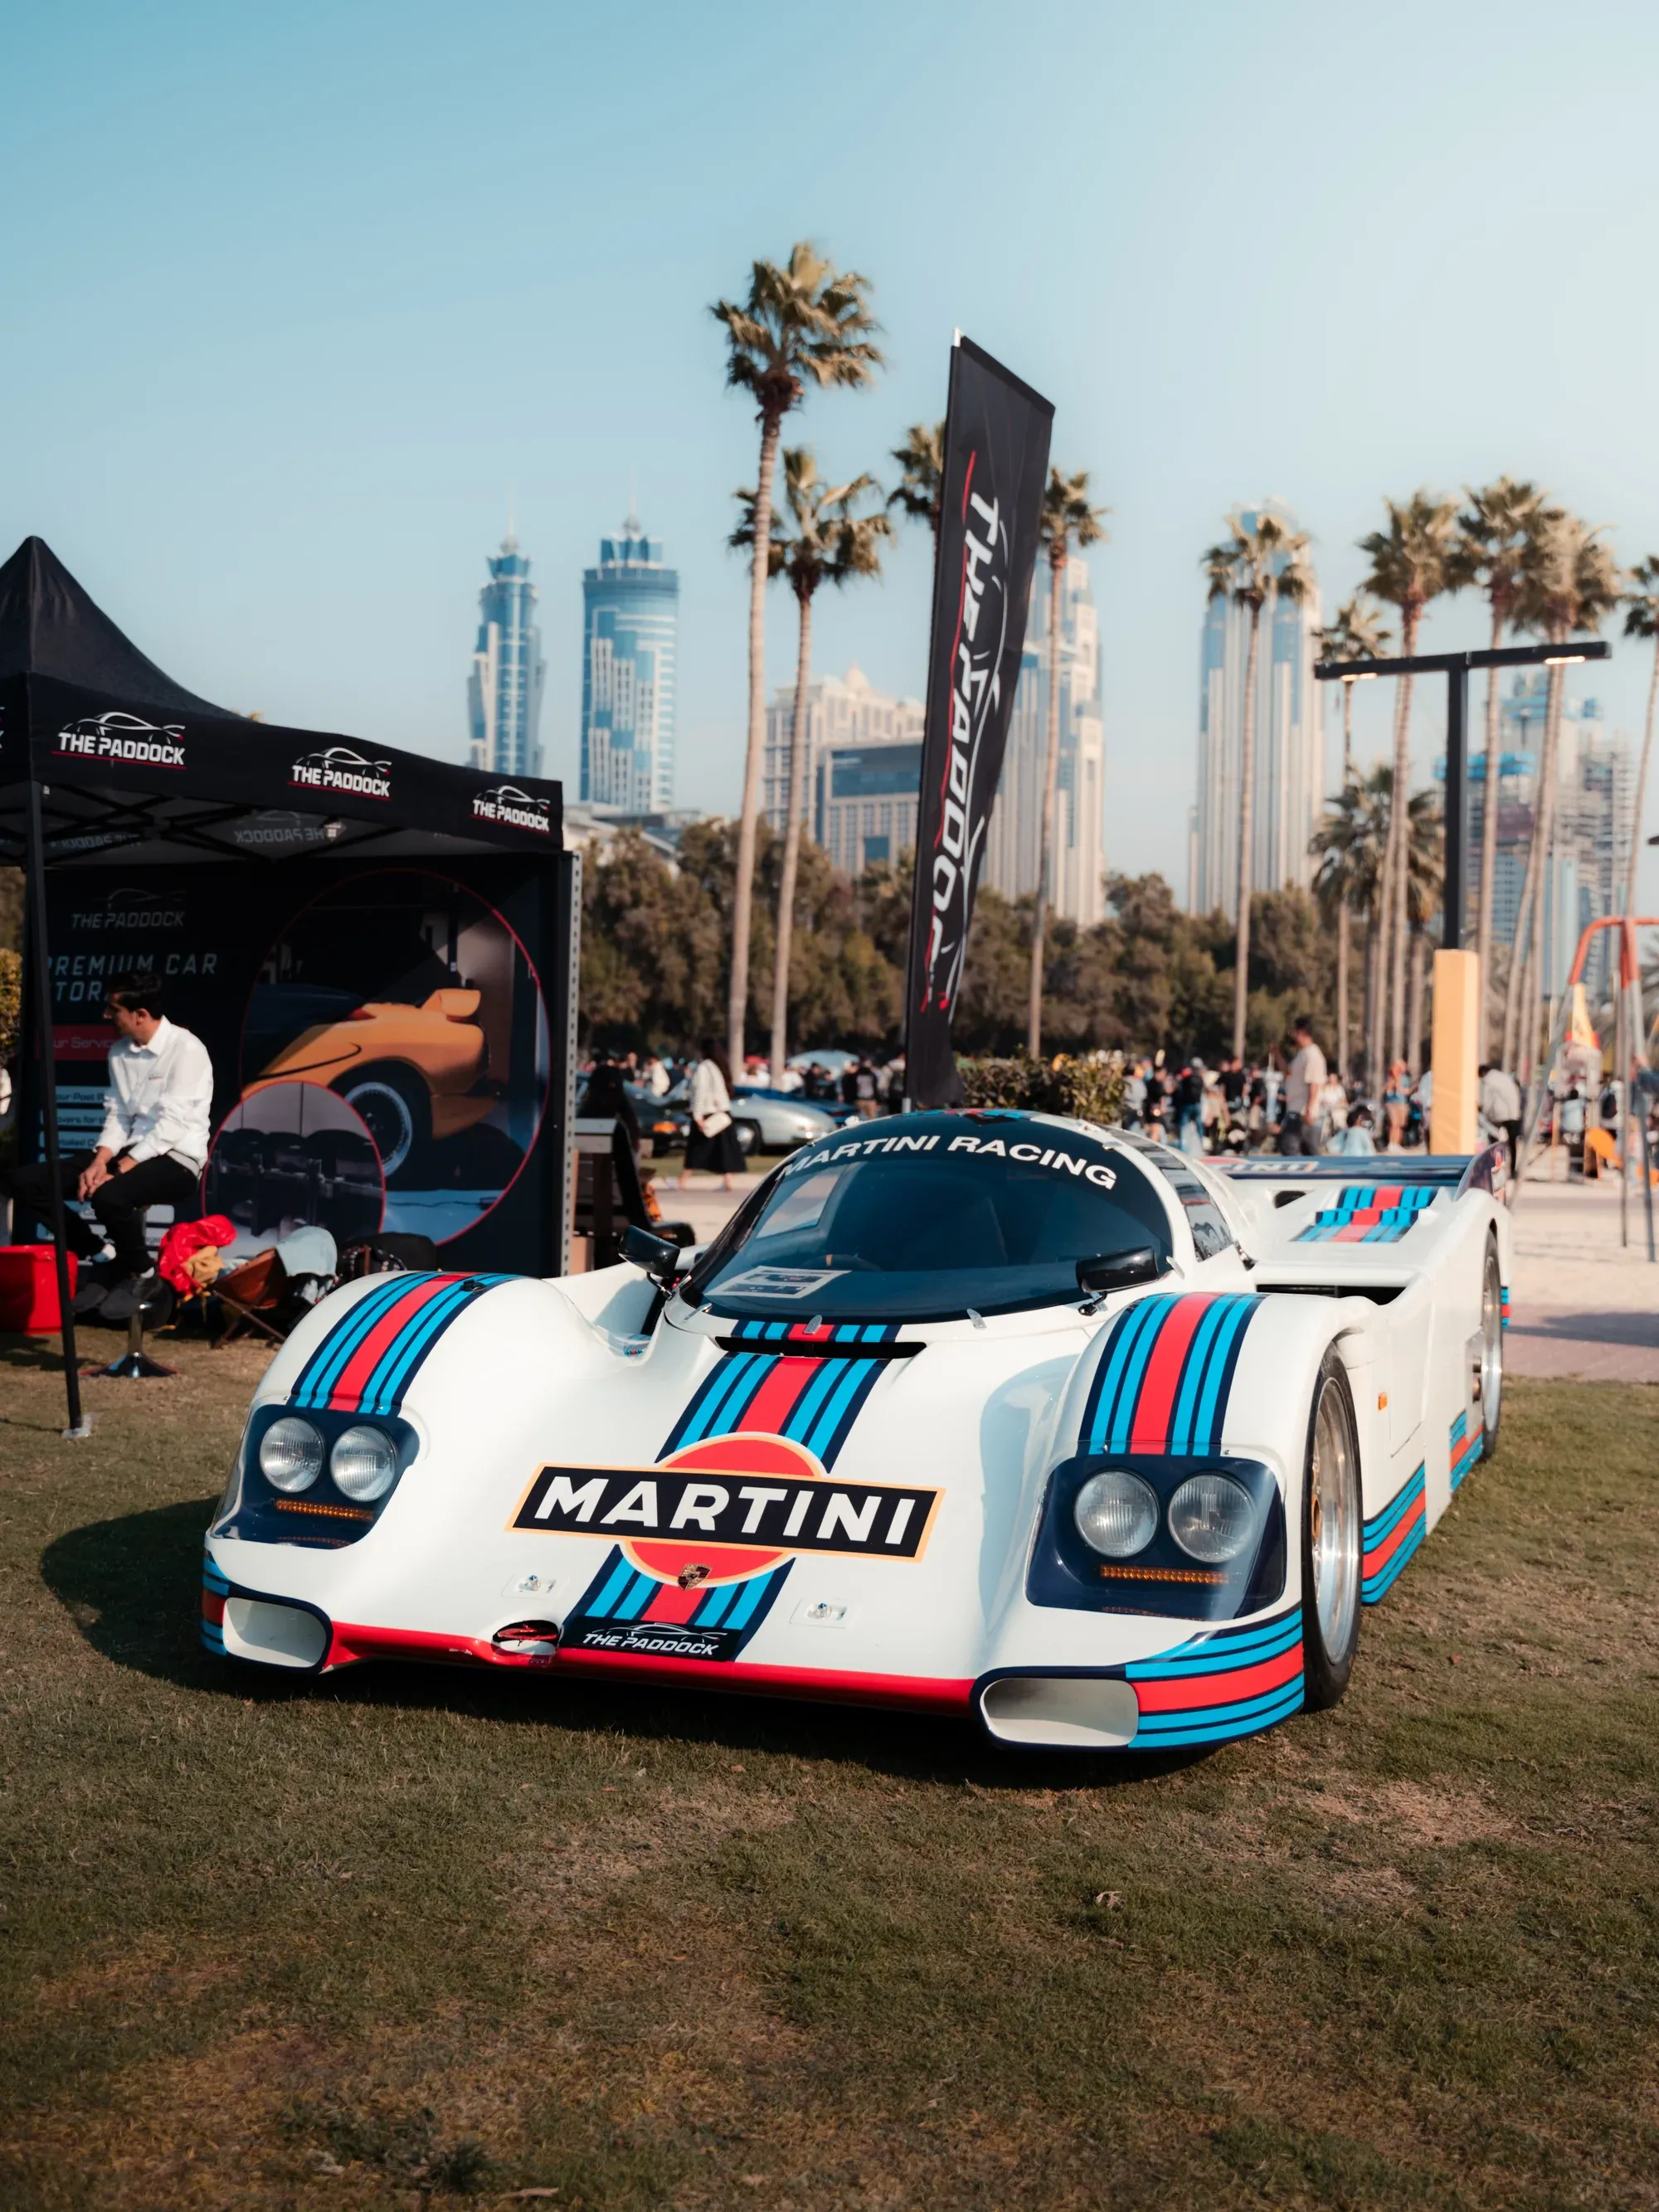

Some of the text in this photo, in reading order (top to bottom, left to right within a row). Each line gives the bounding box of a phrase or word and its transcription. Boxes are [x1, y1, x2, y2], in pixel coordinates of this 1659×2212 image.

[961, 492, 998, 642] THE
[57, 732, 186, 765] THE PADDOCK
[292, 765, 391, 797] THE PADDOCK
[472, 799, 550, 832] THE PADDOCK
[71, 911, 185, 929] THE PADDOCK
[165, 953, 217, 975] CAR
[53, 1036, 114, 1050] ur Servic
[774, 1135, 1117, 1191] MARTINI RACING
[533, 1475, 916, 1545] MARTINI
[582, 1633, 719, 1655] THE PADDOCK
